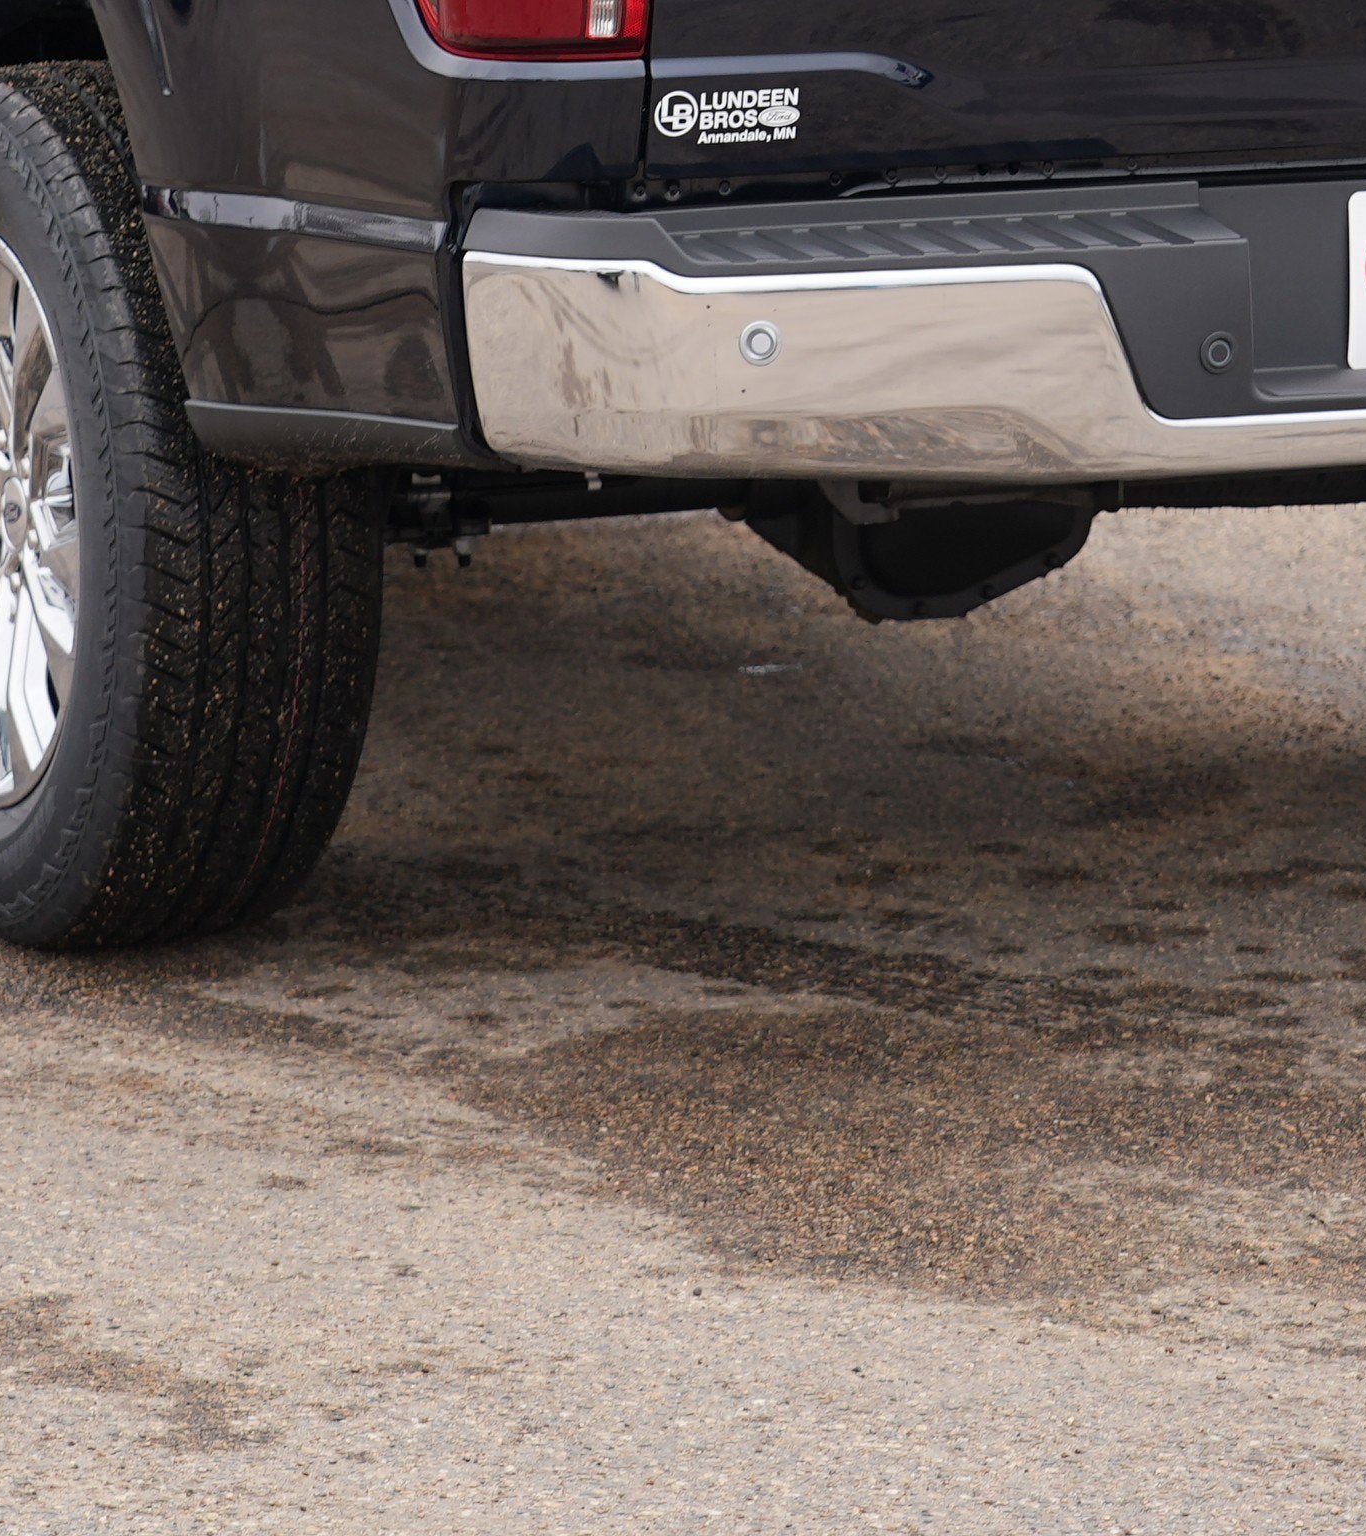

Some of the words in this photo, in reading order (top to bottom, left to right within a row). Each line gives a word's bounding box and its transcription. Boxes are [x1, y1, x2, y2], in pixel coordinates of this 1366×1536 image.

[700, 88, 799, 110] LUNDEEN
[699, 109, 759, 130] BROS
[697, 129, 771, 144] Annandale,
[773, 127, 796, 140] MN
